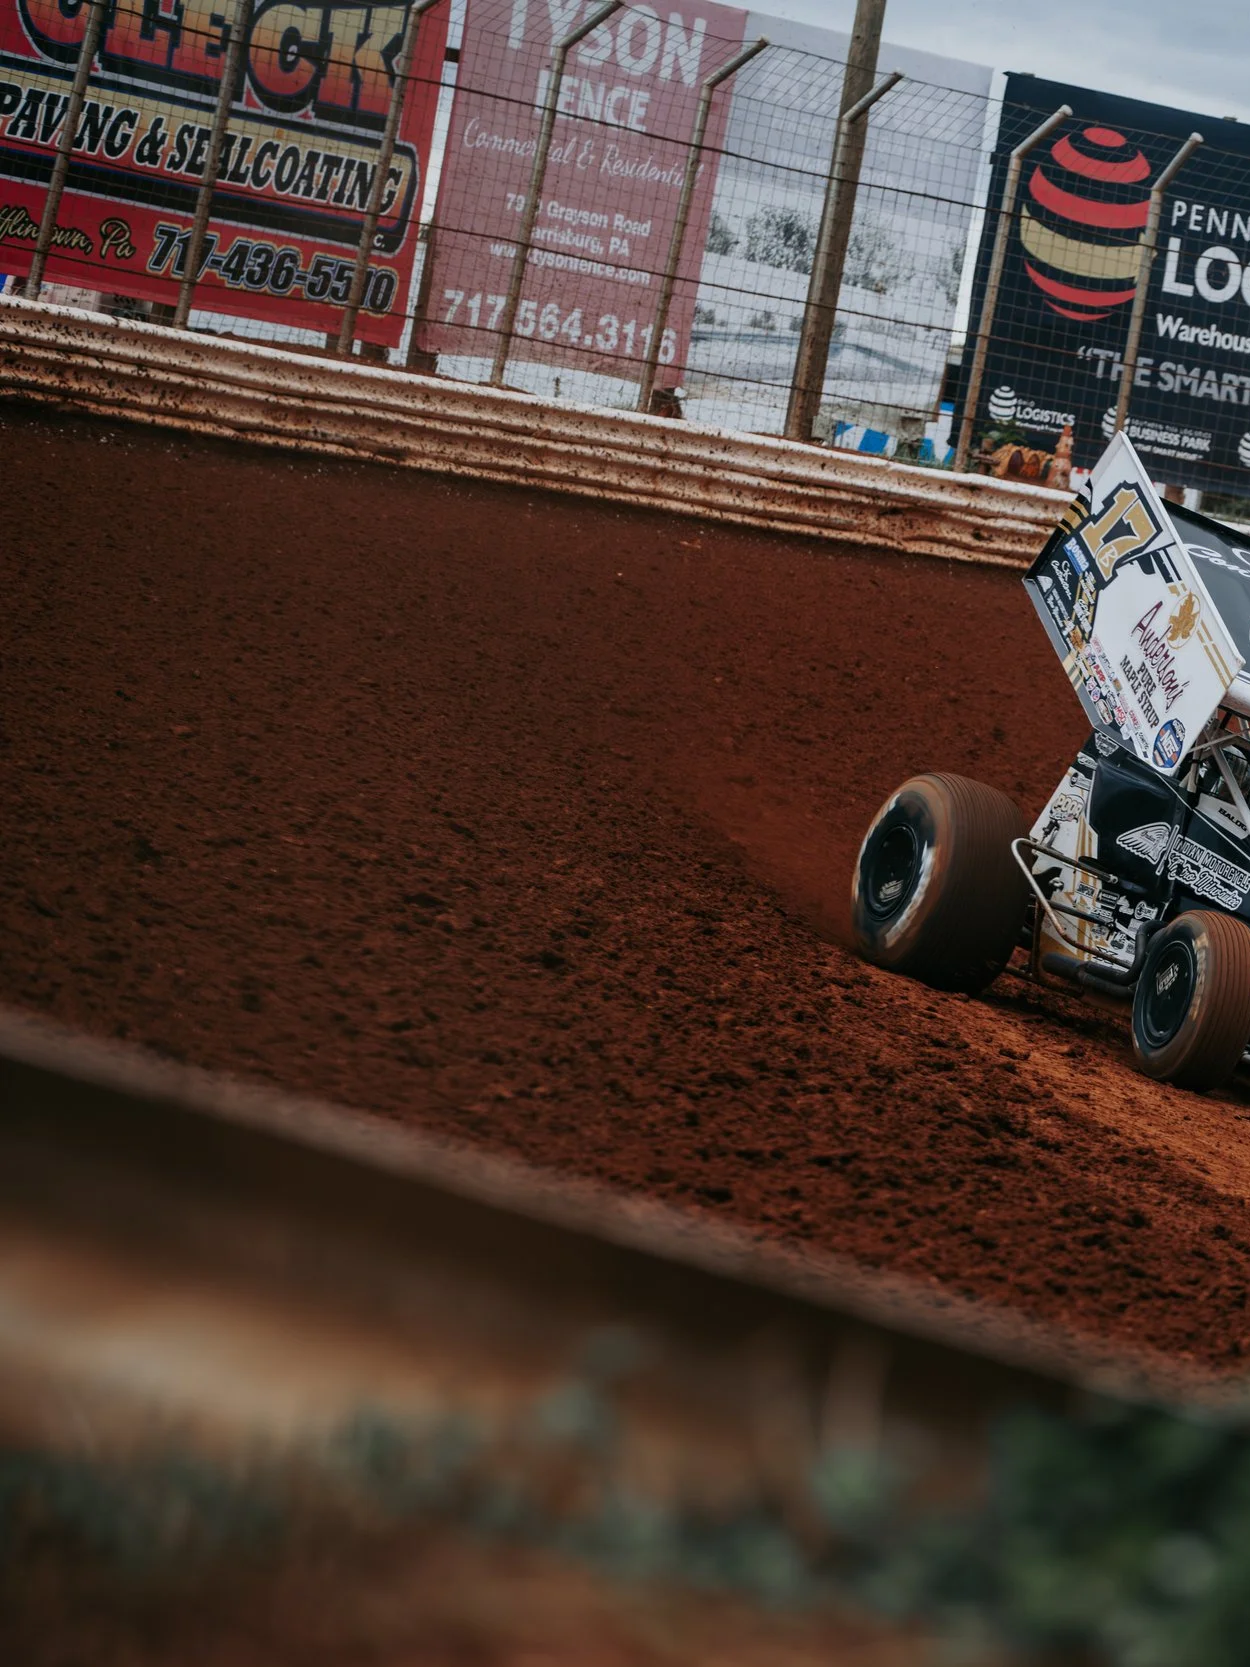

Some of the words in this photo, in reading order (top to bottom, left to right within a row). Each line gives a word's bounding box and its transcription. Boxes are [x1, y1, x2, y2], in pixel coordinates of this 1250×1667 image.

[133, 116, 168, 168] &
[463, 117, 577, 165] Commerial
[600, 144, 705, 190] Residentil
[547, 201, 609, 228] Grayson
[613, 214, 652, 237] Road
[100, 217, 137, 260] Pa
[530, 226, 604, 255] arrisburg,
[609, 235, 630, 258] PA
[1015, 405, 1076, 427] LOGISTICS
[1129, 426, 1181, 447] BUSINESS
[1181, 437, 1210, 451] PARK
[1120, 654, 1141, 695] MAPLE
[1137, 690, 1160, 729] SYRUP
[1137, 661, 1157, 697] PURE
[1218, 807, 1249, 833] BALOG
[1172, 838, 1204, 864] INDIAN
